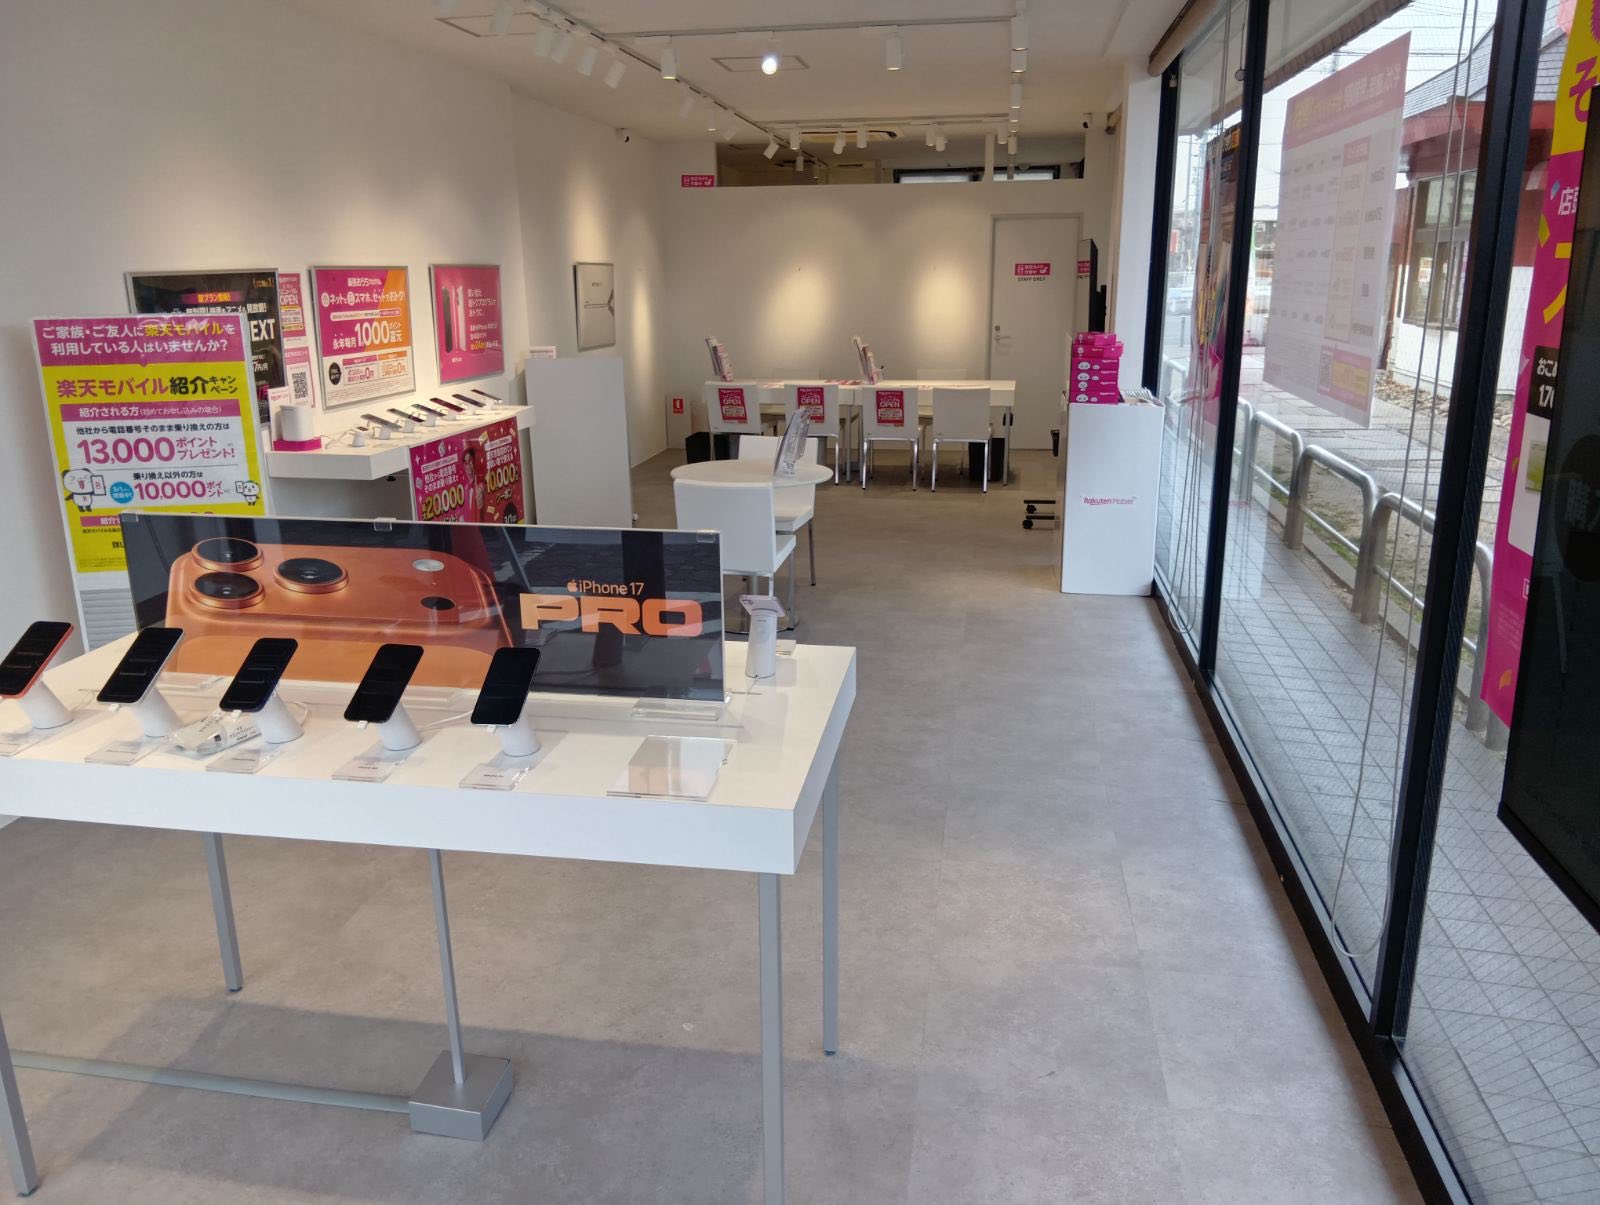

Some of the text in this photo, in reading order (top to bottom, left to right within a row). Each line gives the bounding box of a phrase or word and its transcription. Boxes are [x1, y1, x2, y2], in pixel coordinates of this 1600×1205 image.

[279, 294, 299, 305] OPEN
[42, 323, 236, 340] ご家族・ご友人に楽天モバイルを
[355, 321, 390, 347] 1,000
[51, 340, 228, 356] 利用している人はいませんか?
[76, 423, 230, 436] 他社から電話番号そのまま乗り換えの方は
[77, 437, 217, 465] 13,000 ポイント
[177, 447, 236, 461] プレゼント!
[133, 471, 203, 480] 乗り換え以外の方は
[485, 463, 516, 493] 10,000
[133, 480, 207, 500] 10,000
[425, 484, 465, 520] 20,000
[1083, 498, 1112, 506] Rakuten
[579, 580, 645, 596] iPhone 17
[519, 593, 703, 638] PRO
